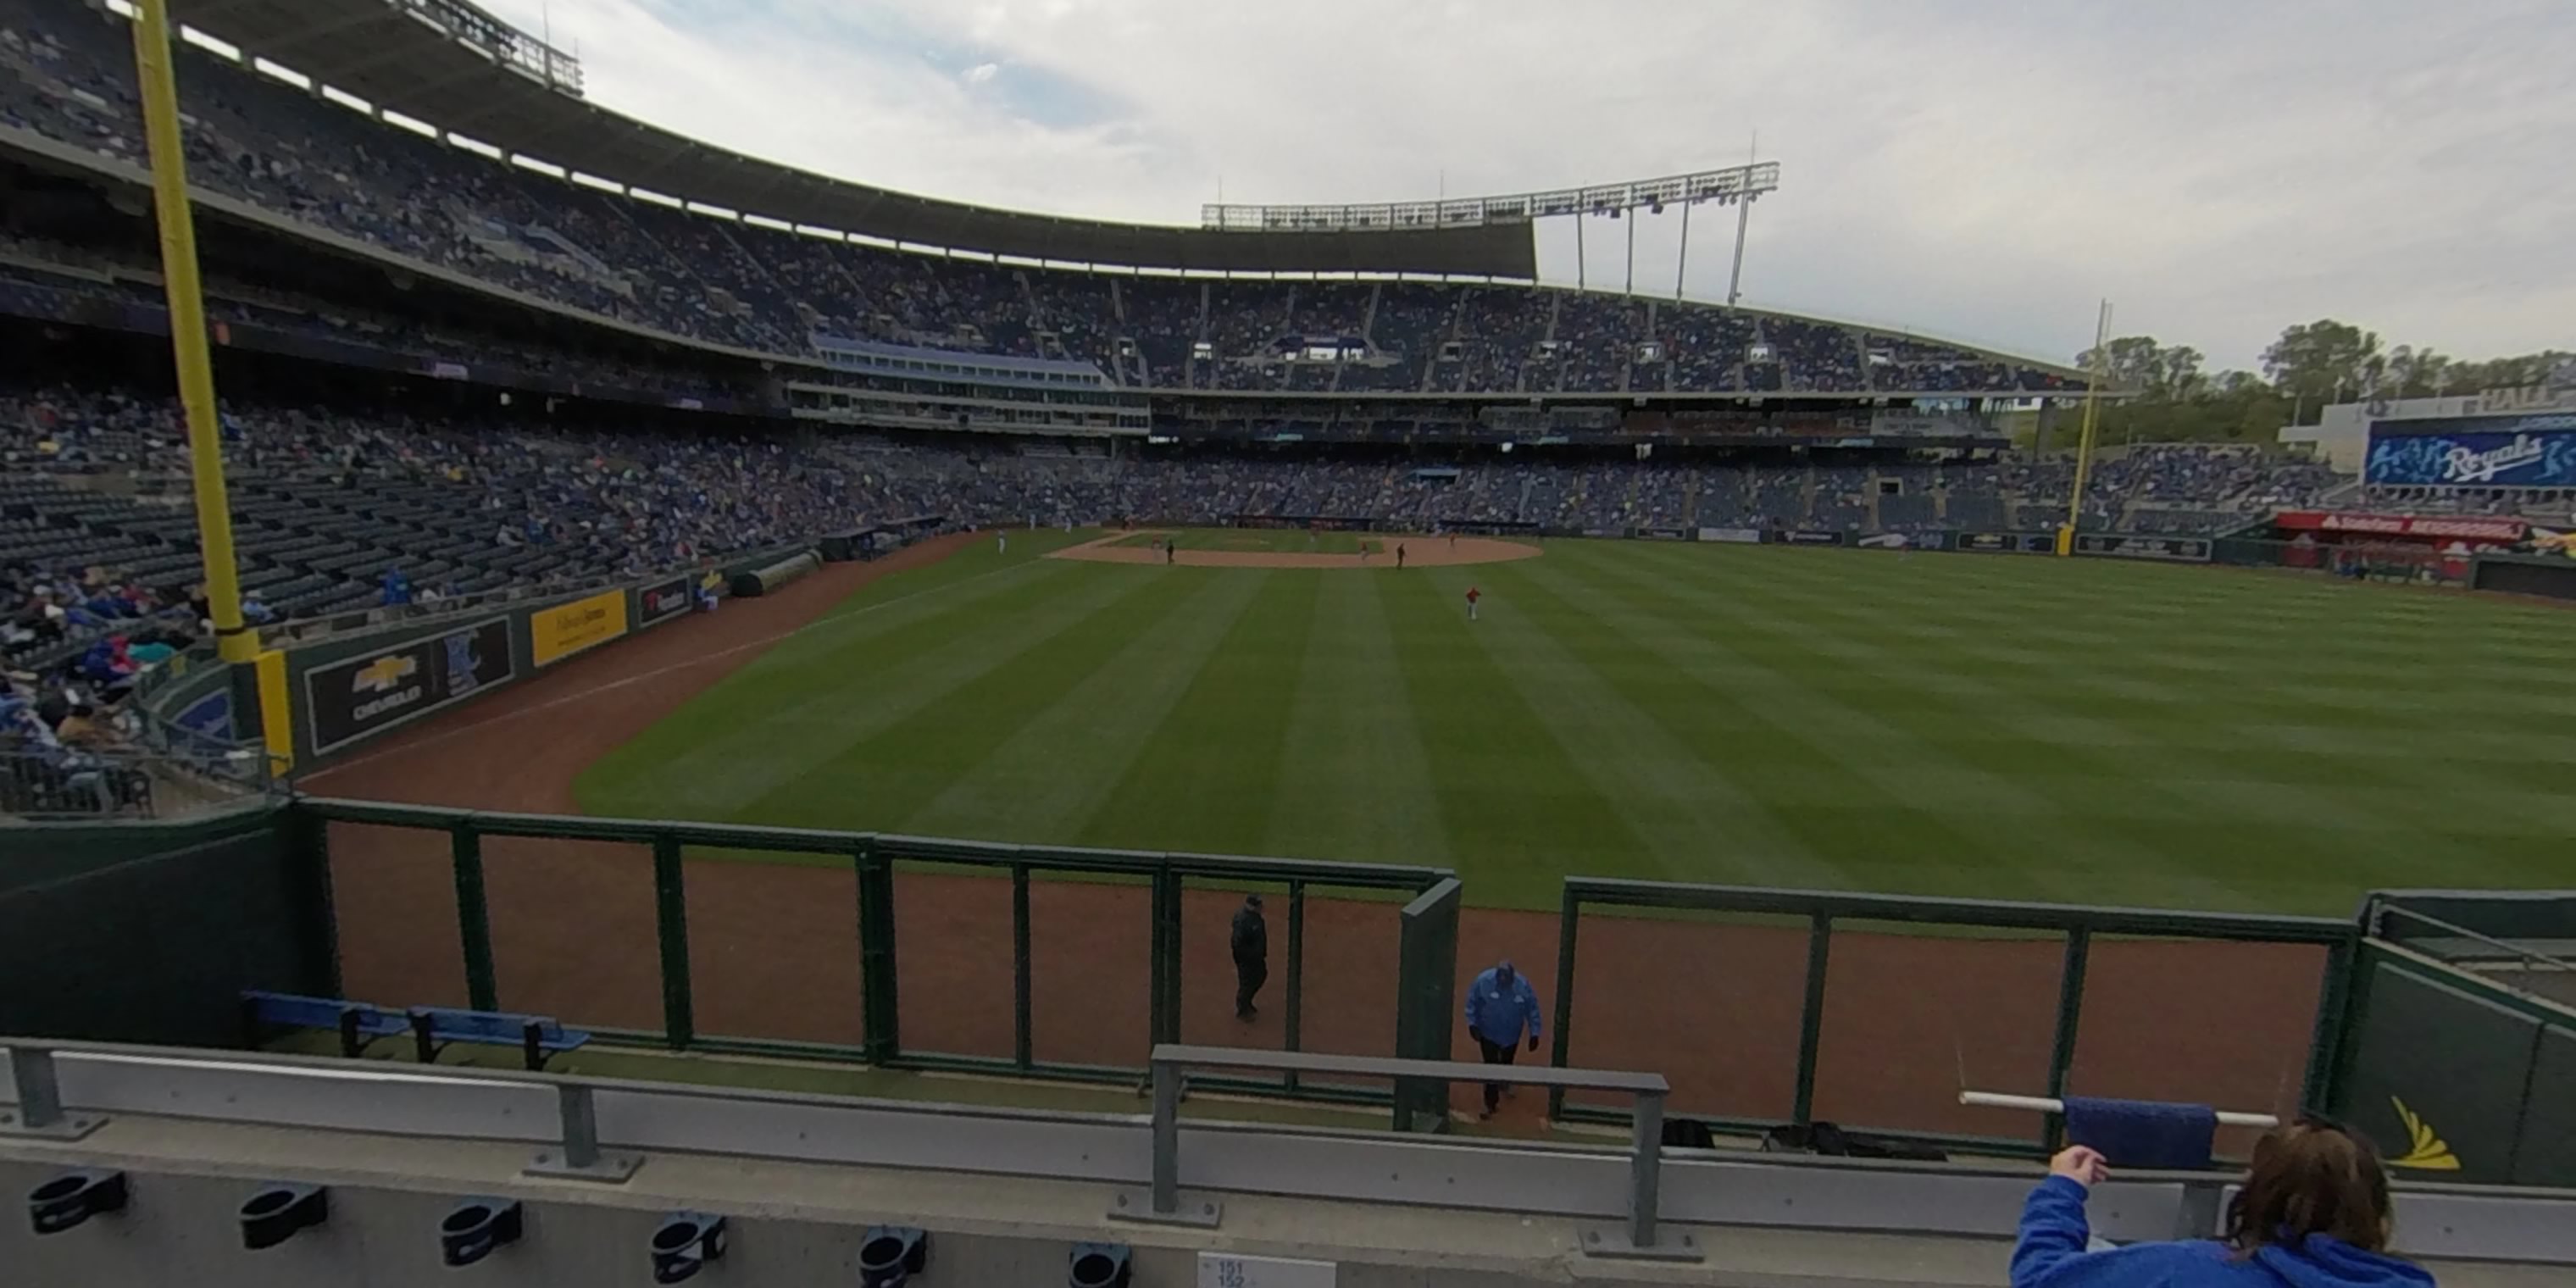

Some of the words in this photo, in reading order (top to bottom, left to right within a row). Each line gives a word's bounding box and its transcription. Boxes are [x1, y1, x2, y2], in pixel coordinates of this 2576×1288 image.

[2479, 385, 2559, 412] HALL
[2442, 434, 2542, 481] Royals
[1219, 1261, 1243, 1275] 151
[1219, 1274, 1246, 1288] 152
